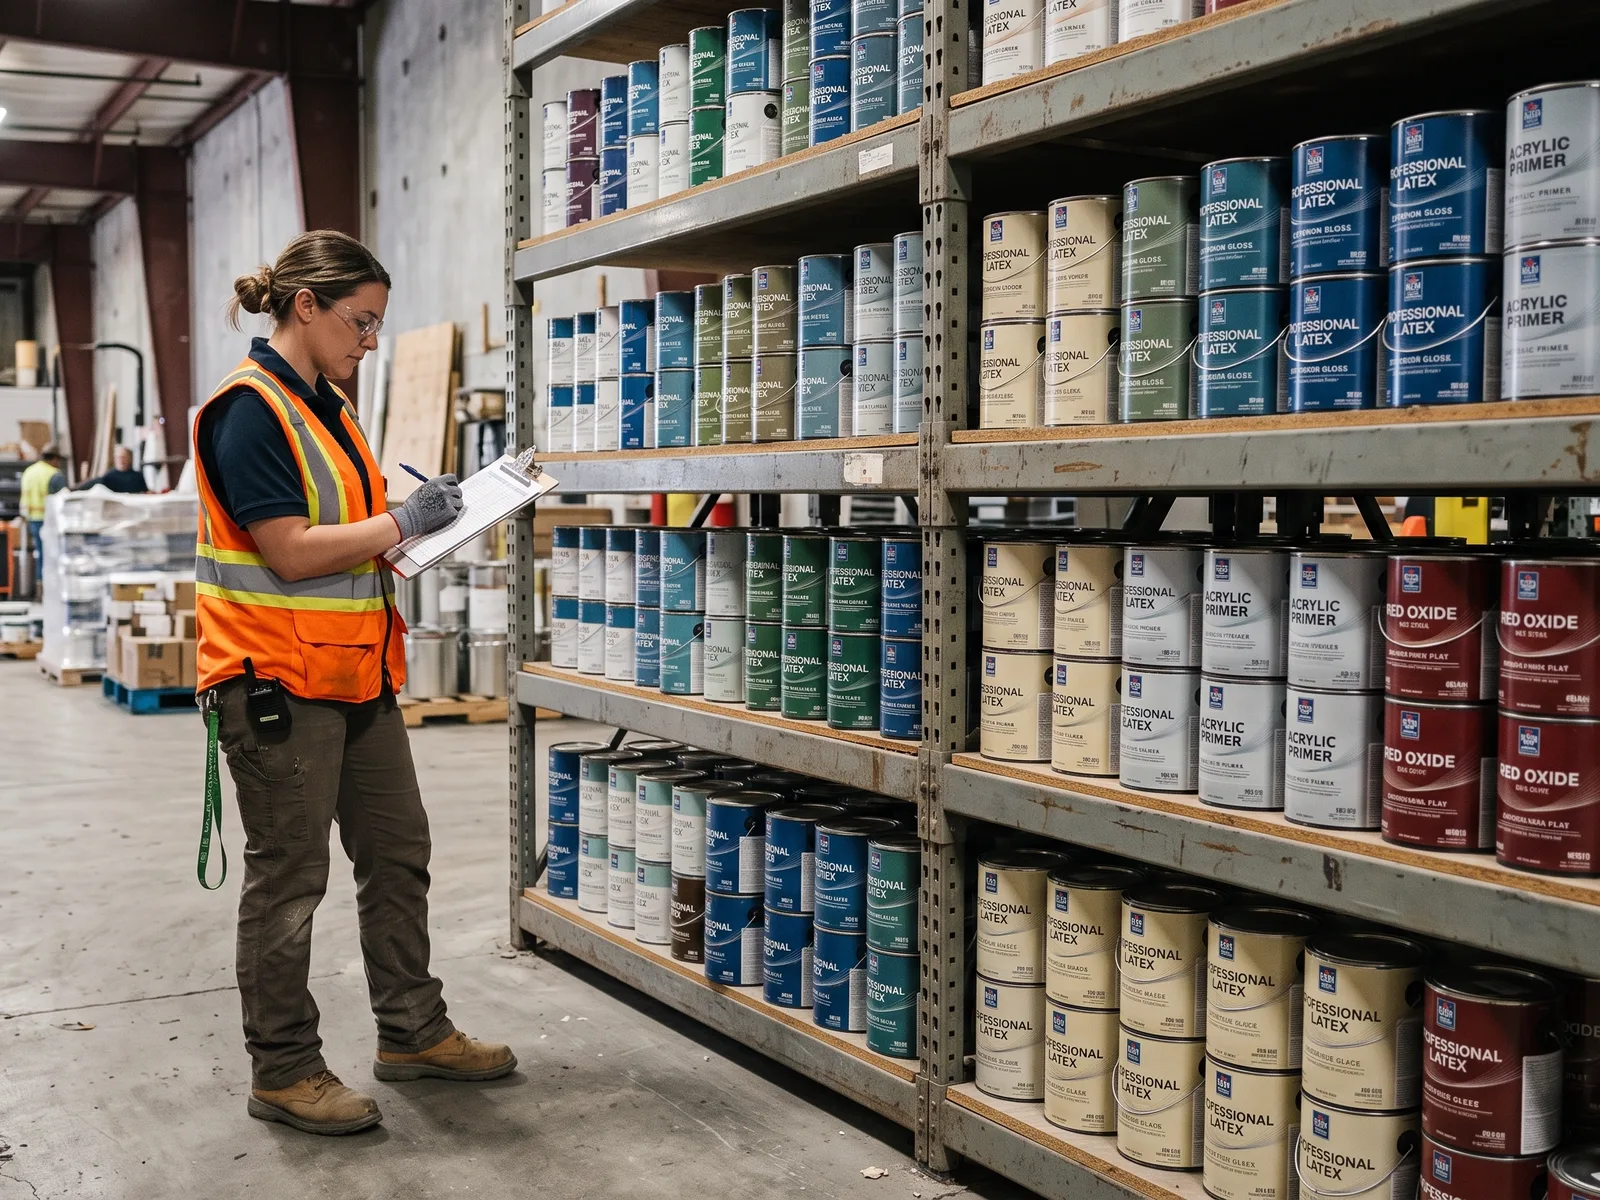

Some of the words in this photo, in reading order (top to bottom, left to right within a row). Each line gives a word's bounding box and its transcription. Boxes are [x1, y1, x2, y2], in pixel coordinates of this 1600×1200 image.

[1509, 136, 1570, 161] ACRYLIC
[1509, 153, 1566, 177] PRIMER
[1397, 173, 1437, 192] LATEX
[1299, 193, 1336, 211] LATEX
[1424, 206, 1453, 217] GLOSS
[1205, 212, 1238, 229] LATEX
[1227, 242, 1254, 251] GLOSS
[986, 260, 1012, 272] LATEX
[1507, 294, 1567, 314] ACRYLIC
[1393, 320, 1435, 336] LATEX
[1507, 310, 1564, 330] PRIMER
[1294, 333, 1333, 347] LATEX
[1202, 342, 1237, 356] LATEX
[1126, 597, 1155, 610] LATEX
[1205, 591, 1252, 605] ACRYLIC
[1292, 598, 1340, 613] ACRYLIC
[1205, 605, 1249, 617] PRIMER
[1292, 612, 1337, 627] PRIMER
[1386, 603, 1404, 618] RED
[1407, 605, 1457, 621] OXIDE
[1501, 611, 1520, 627] RED
[1524, 614, 1579, 630] OXIDE
[1201, 720, 1245, 734] ACRYLIC
[1201, 733, 1242, 747] PRIMER
[1288, 731, 1336, 748] ACRYLIC
[1288, 746, 1333, 763] PRIMER
[1384, 746, 1403, 763] RED
[1405, 752, 1456, 769] OXIDE
[1500, 762, 1520, 781] RED
[1524, 768, 1580, 787] OXIDE
[980, 909, 1008, 925] LATEX
[1050, 929, 1078, 946] LATEX
[1124, 954, 1154, 970] LATEX
[1212, 978, 1246, 998] LATEX
[1311, 1012, 1349, 1034] LATEX
[980, 1025, 1008, 1040] LATEX
[1048, 1050, 1077, 1068] LATEX
[1429, 1047, 1467, 1073] LATEX
[1122, 1082, 1152, 1101] LATEX
[1453, 1096, 1480, 1108] GLEES
[1210, 1114, 1244, 1137] LATEX
[1306, 1155, 1342, 1181] LATEX
